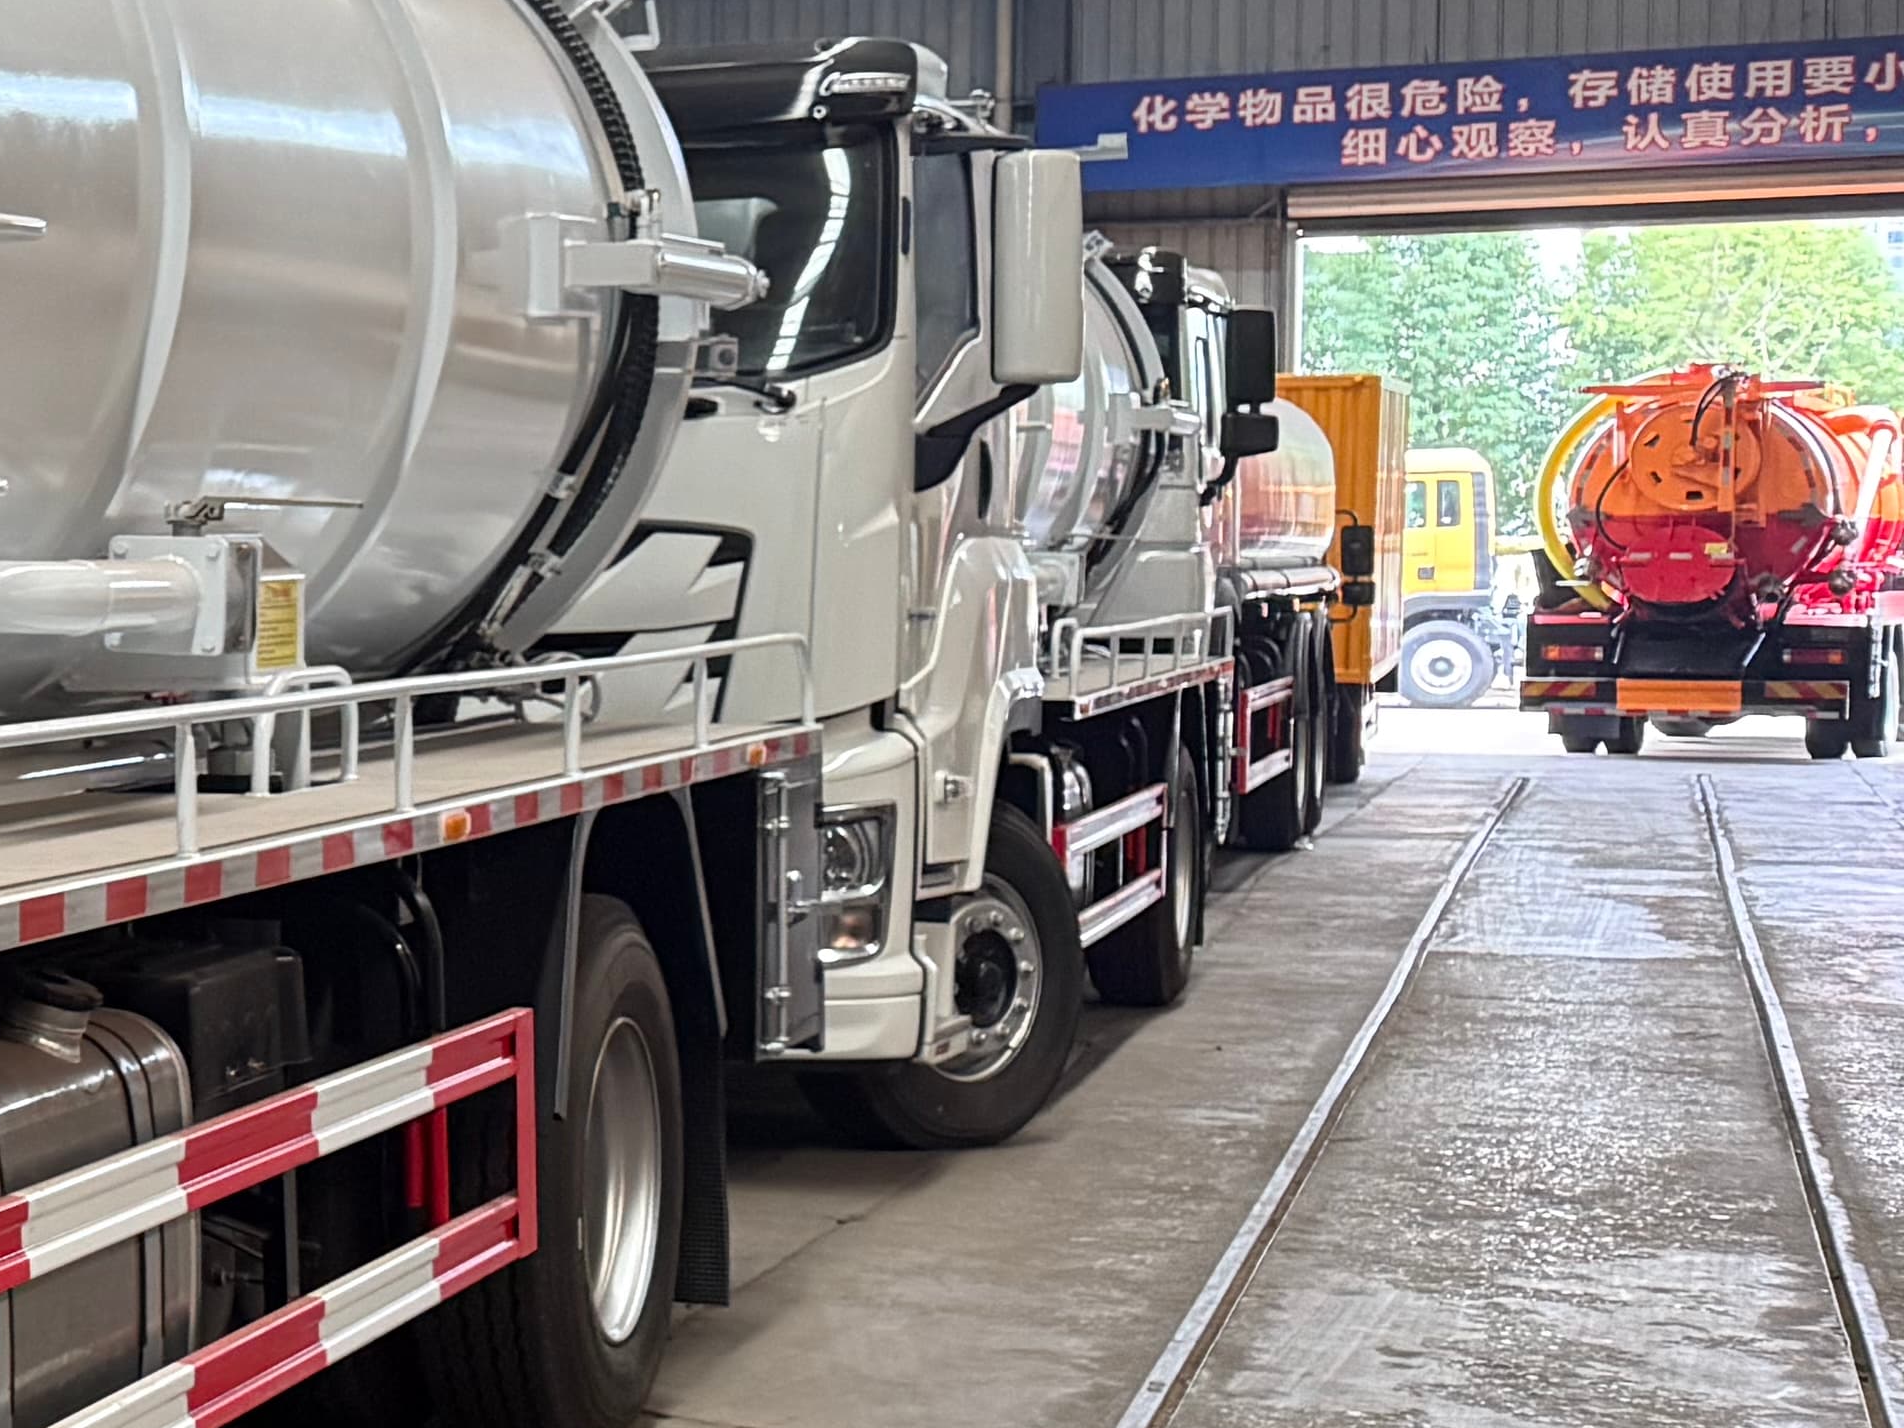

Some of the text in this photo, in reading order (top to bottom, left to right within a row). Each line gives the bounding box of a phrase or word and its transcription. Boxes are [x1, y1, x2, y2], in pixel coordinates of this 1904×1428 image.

[1340, 103, 1879, 166] 细心观察，认真分析，
